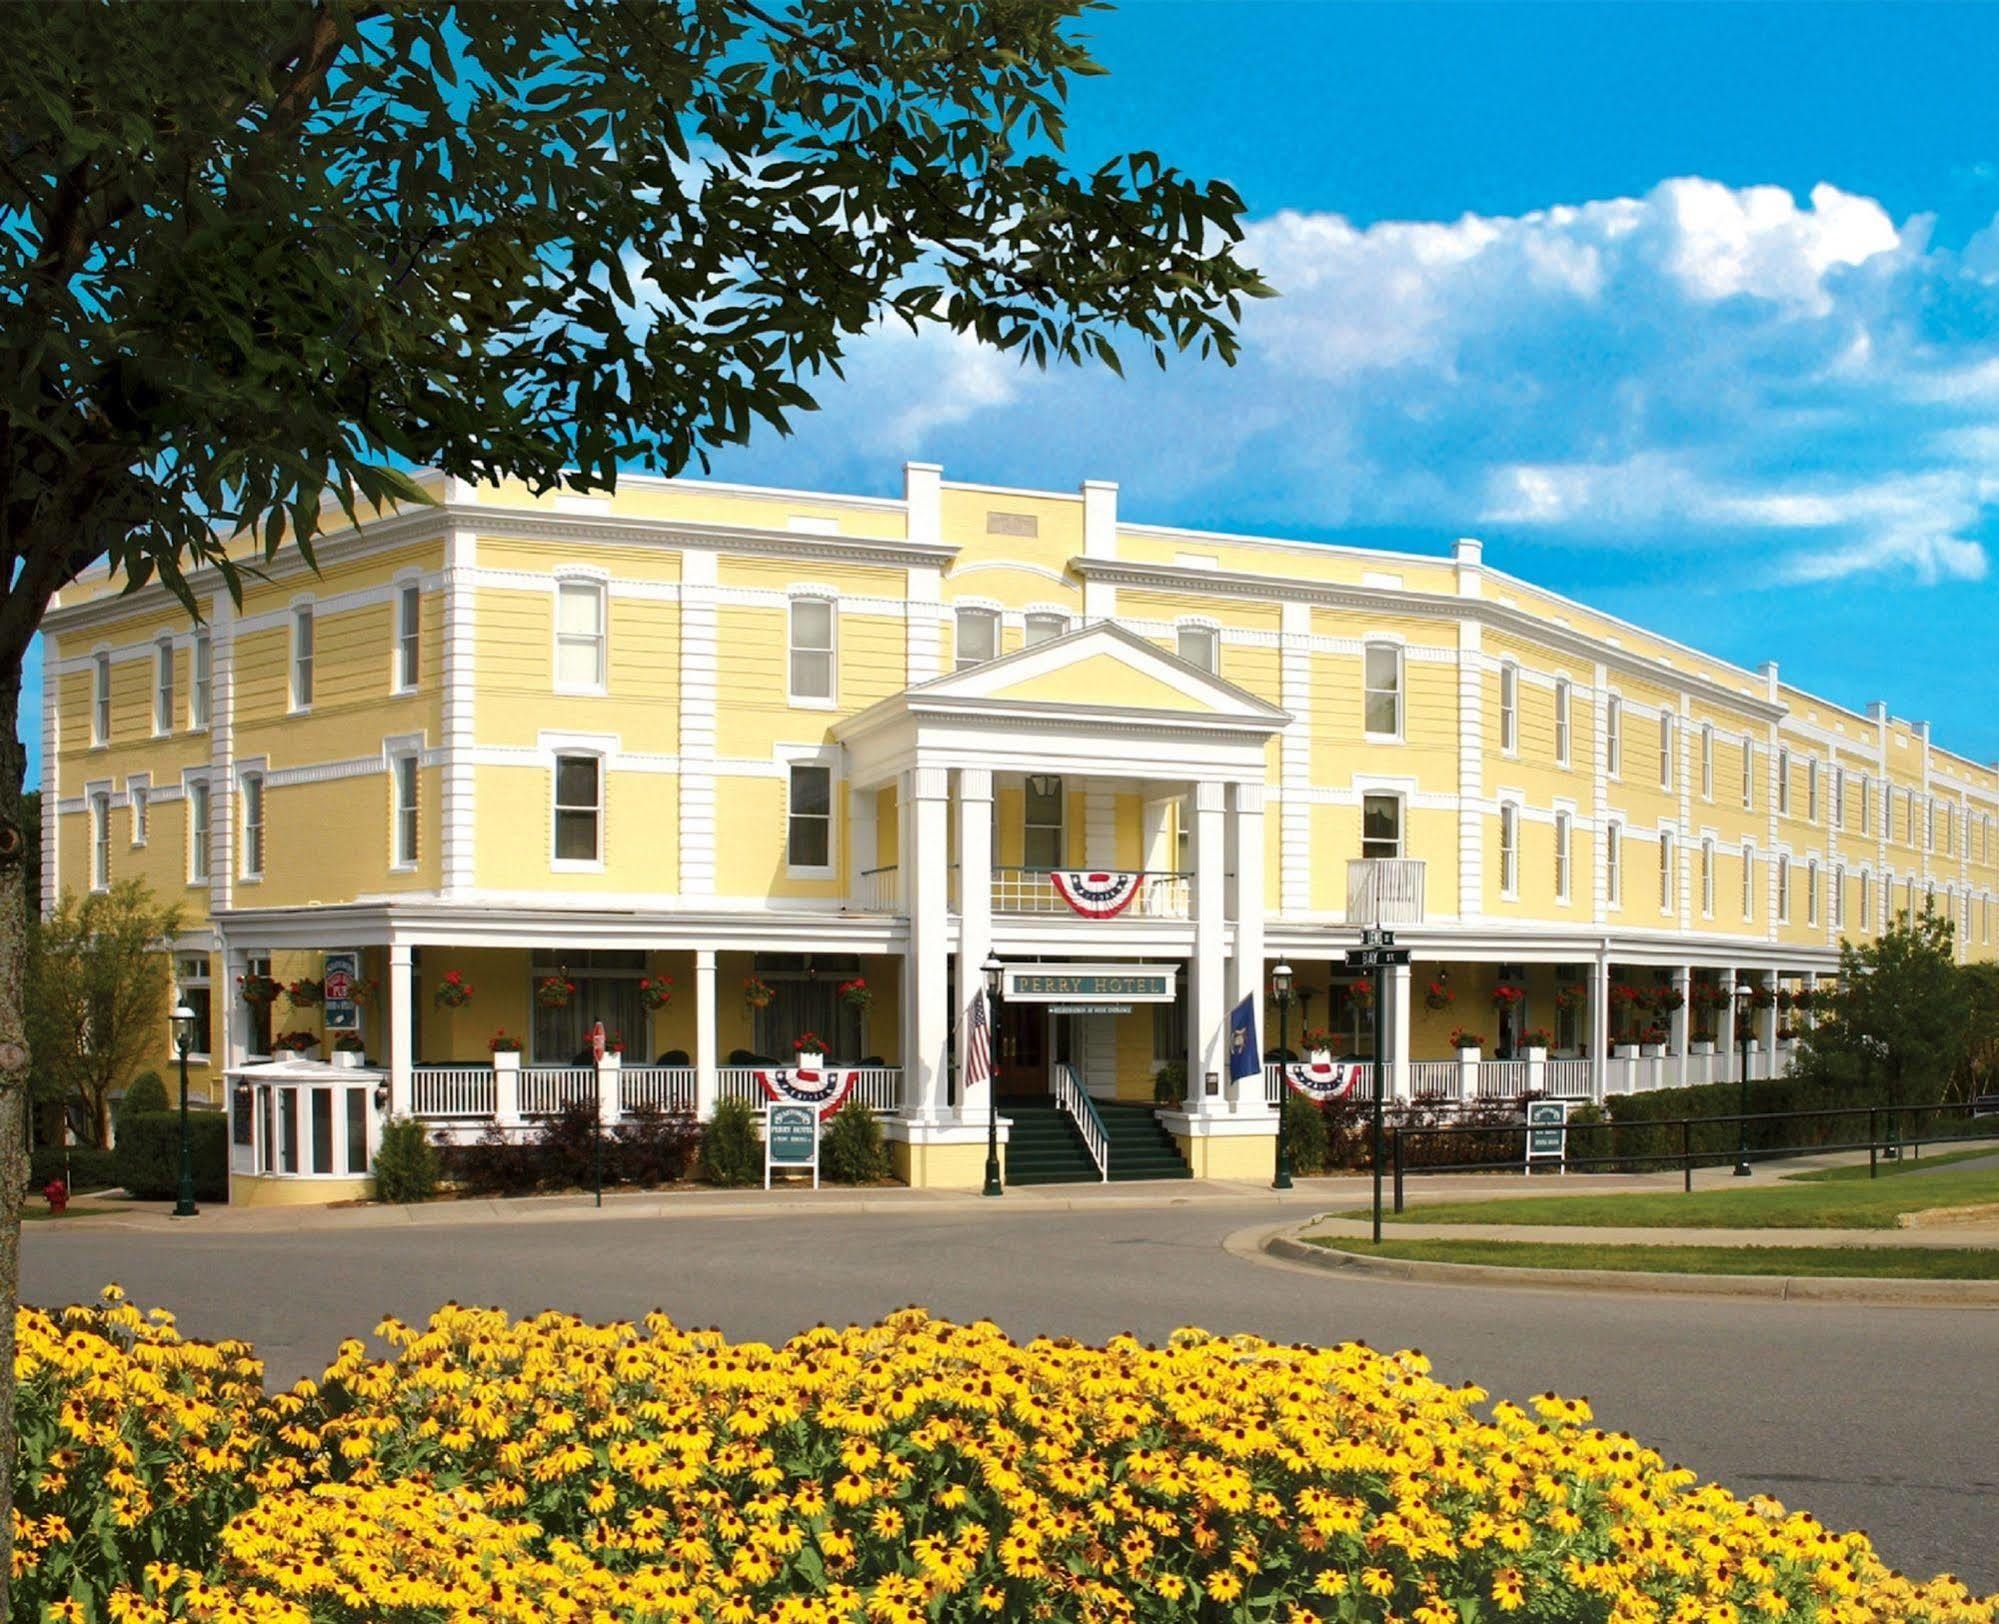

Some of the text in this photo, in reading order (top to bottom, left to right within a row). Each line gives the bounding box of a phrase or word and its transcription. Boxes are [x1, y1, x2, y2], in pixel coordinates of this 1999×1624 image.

[1362, 951, 1378, 965] BAY
[1019, 977, 1160, 993] PERRY HOTEL
